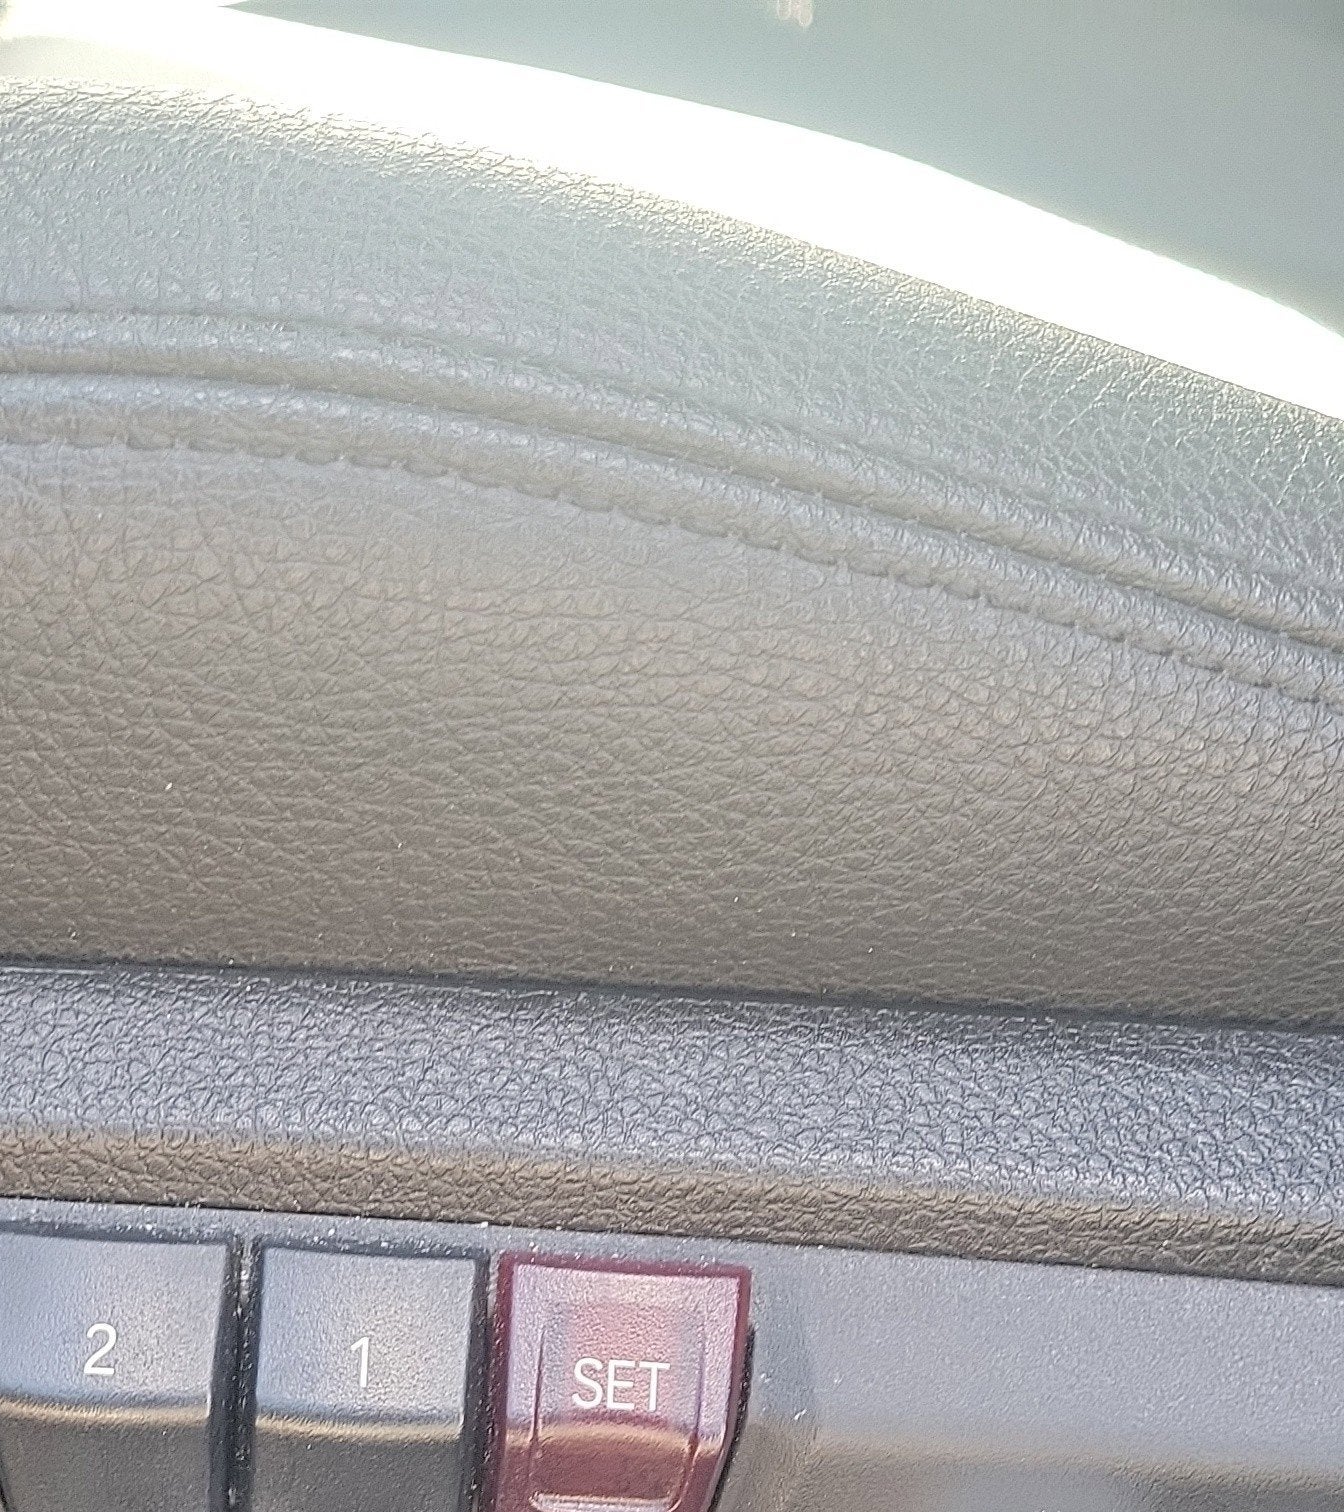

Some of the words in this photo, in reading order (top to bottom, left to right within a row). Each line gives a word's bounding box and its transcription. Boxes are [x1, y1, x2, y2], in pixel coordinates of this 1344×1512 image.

[84, 1322, 118, 1376] 2
[349, 1336, 371, 1388] 1
[571, 1356, 671, 1413] SET
